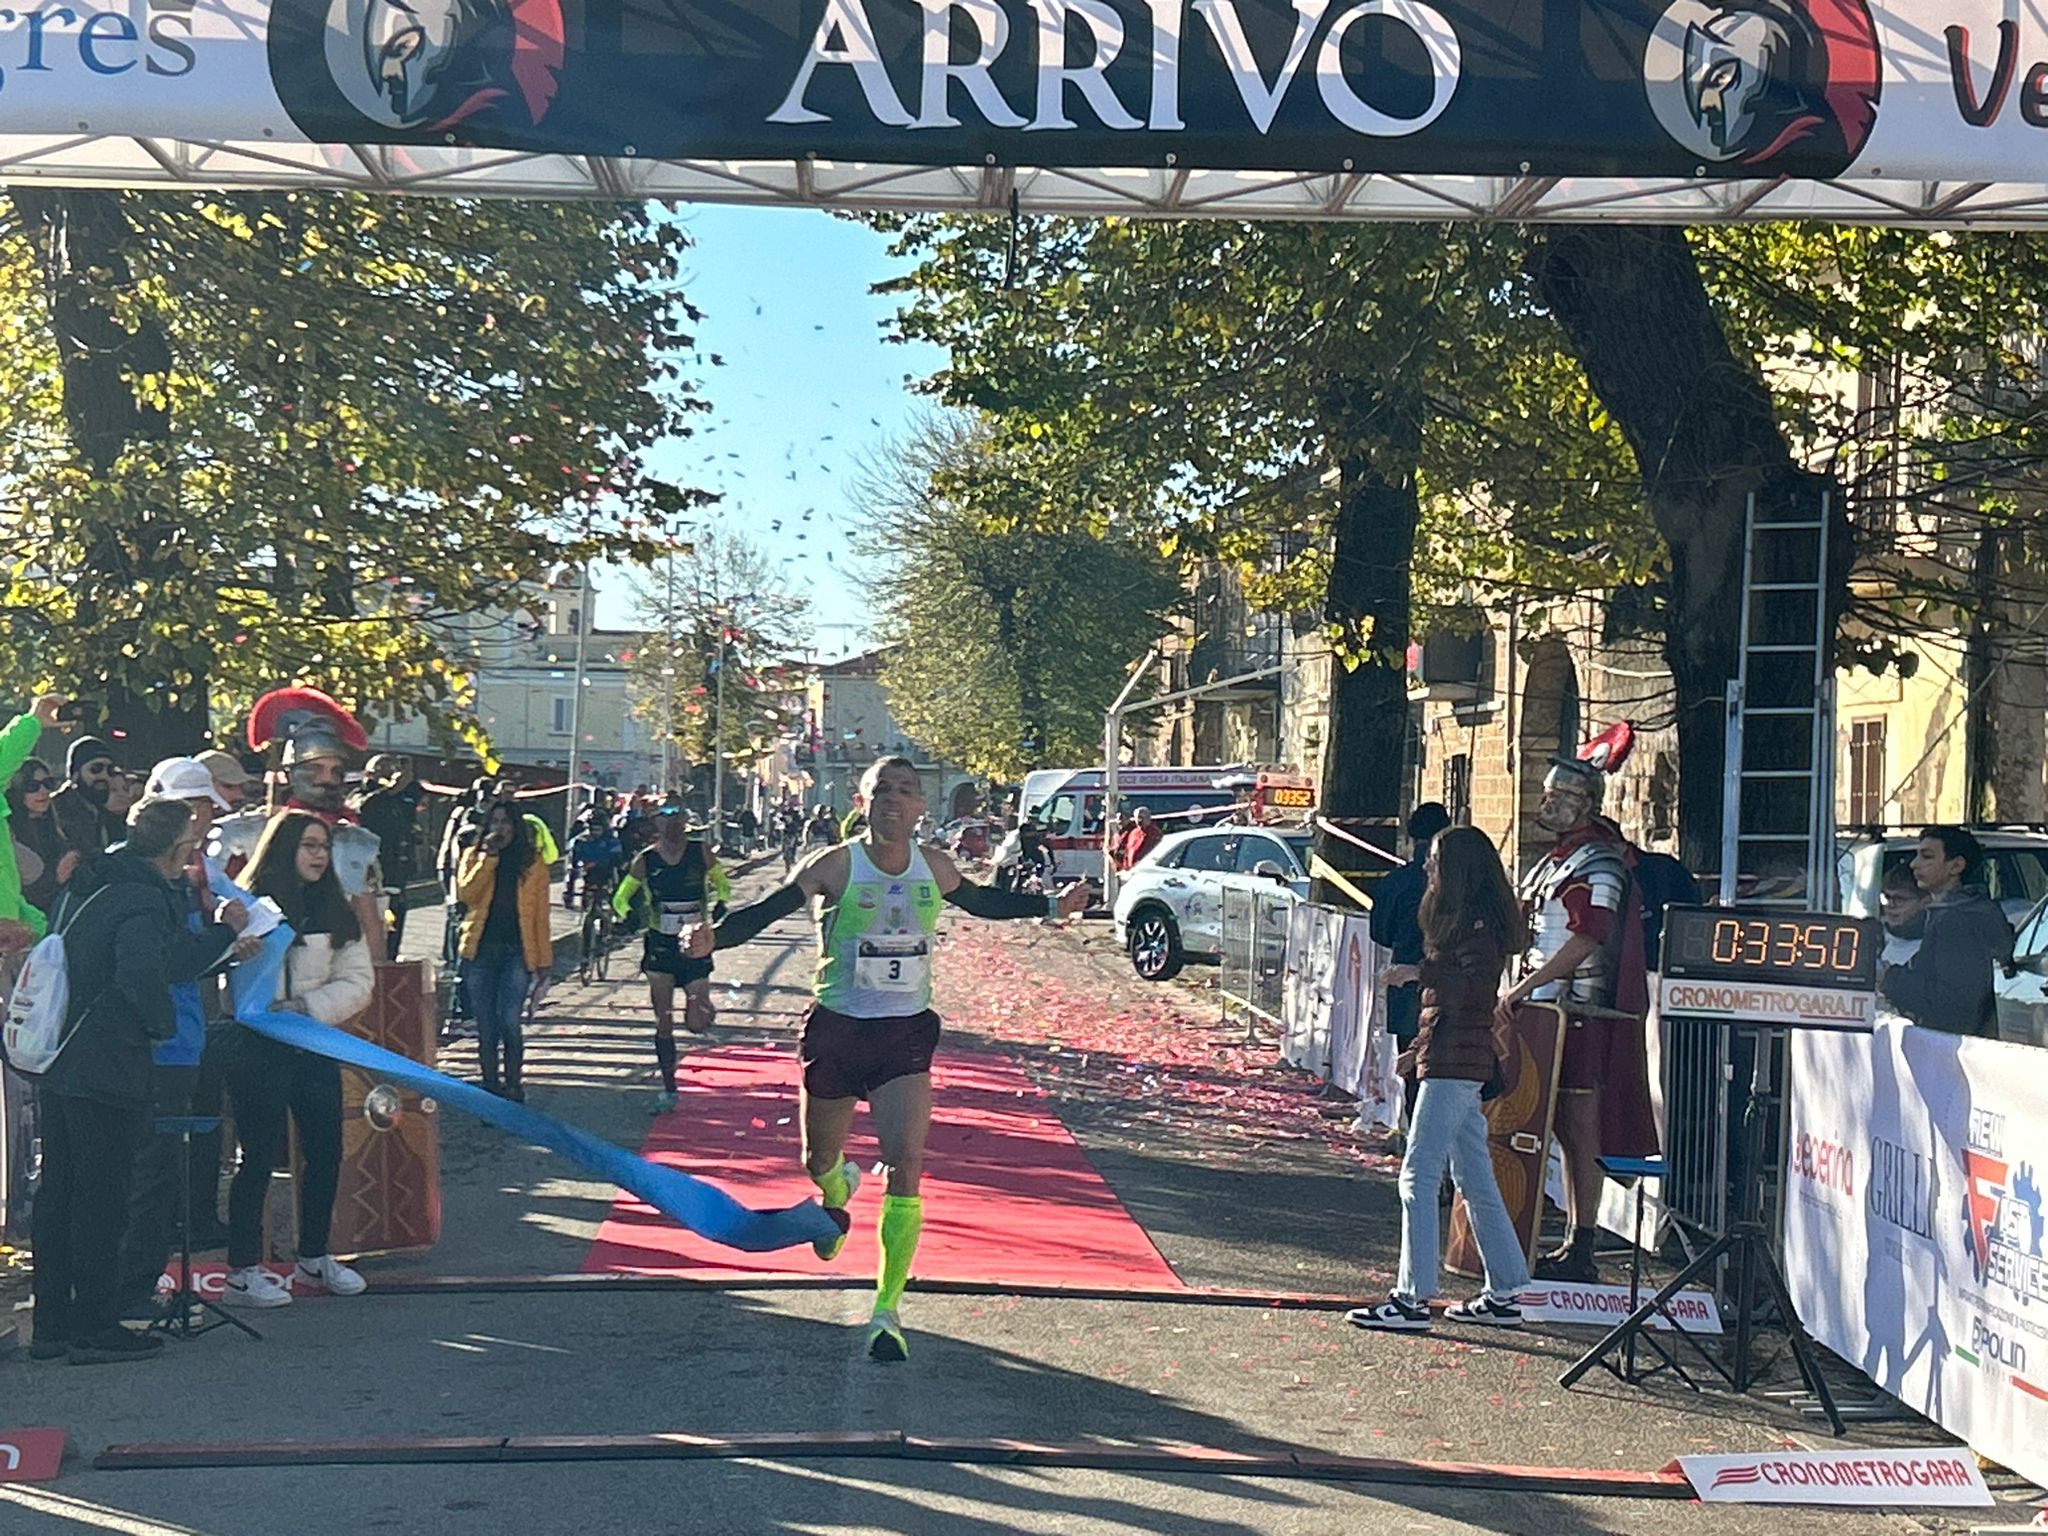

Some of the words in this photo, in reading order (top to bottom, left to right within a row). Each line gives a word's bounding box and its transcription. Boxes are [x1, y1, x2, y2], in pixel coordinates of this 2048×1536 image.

[0, 6, 195, 92] res
[766, 0, 1461, 136] ARRIVO
[1139, 775, 1169, 784] ROSSA
[1171, 774, 1210, 784] ITALIANA
[1712, 919, 1859, 970] 0:33:50
[888, 960, 901, 980] 3
[1669, 985, 1869, 1017] CRONOMETROGARA.IT
[1870, 1136, 1934, 1240] GRILLI
[1551, 1289, 1710, 1321] CRONOMEGARA
[1760, 1459, 1973, 1487] CRONOMETROGARA
